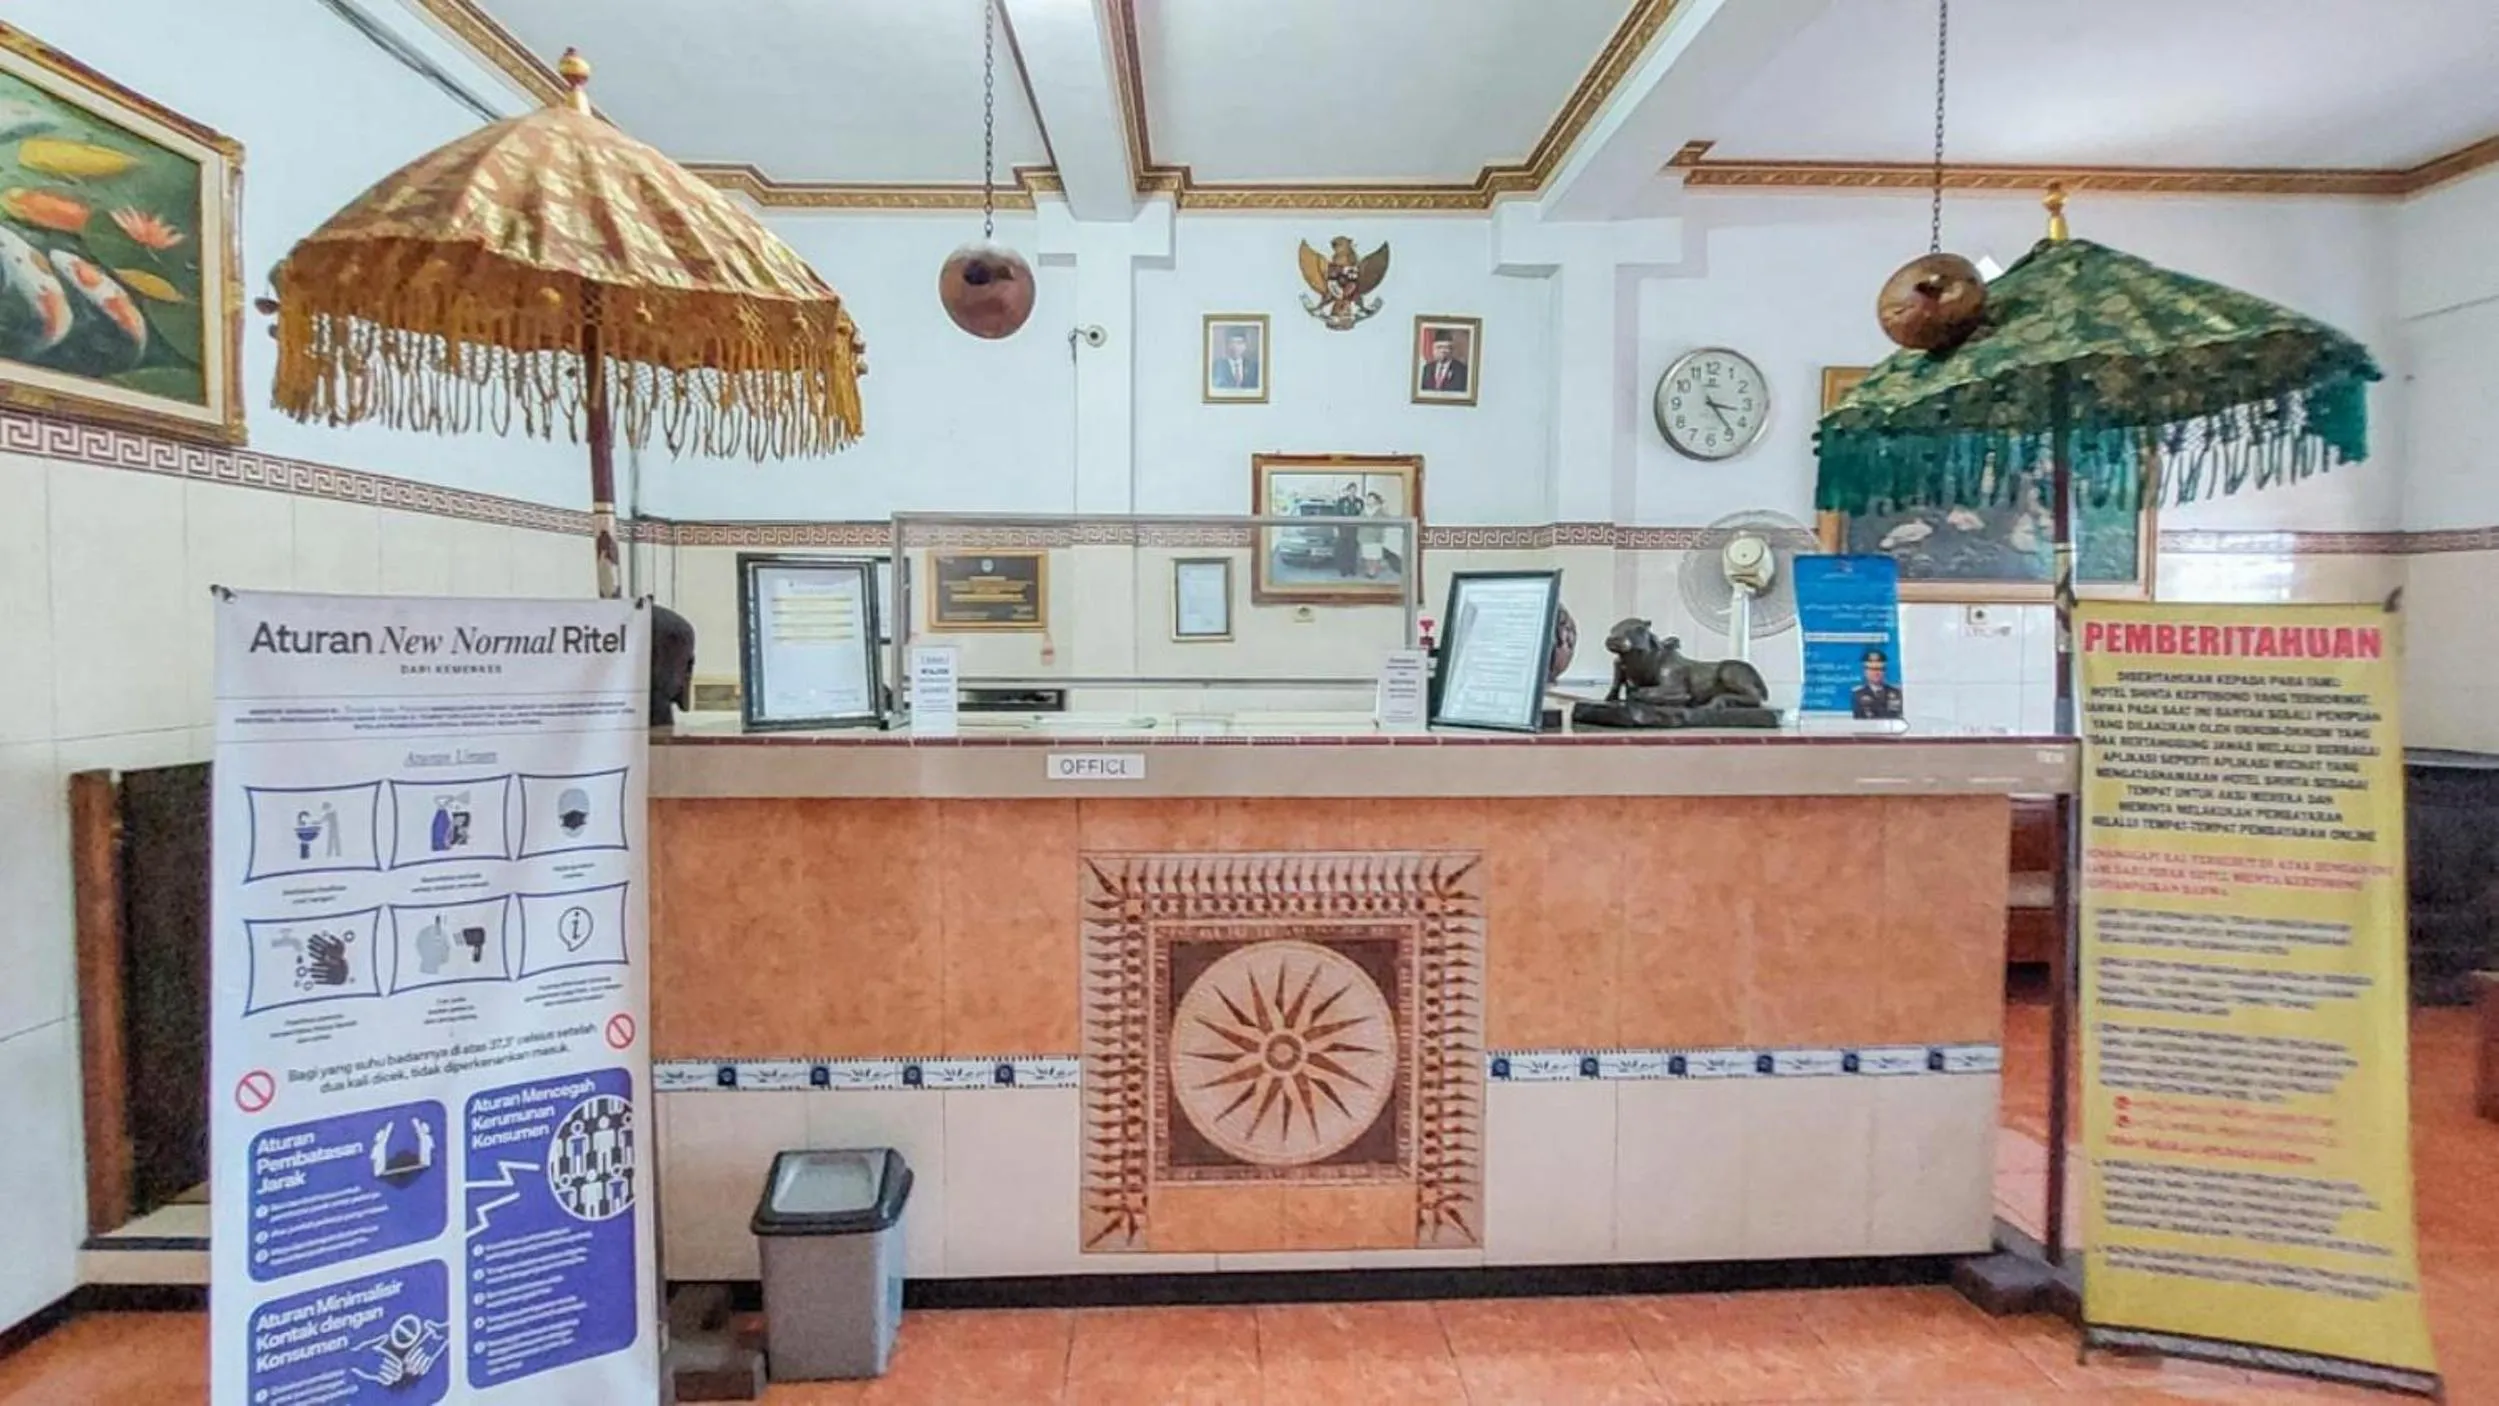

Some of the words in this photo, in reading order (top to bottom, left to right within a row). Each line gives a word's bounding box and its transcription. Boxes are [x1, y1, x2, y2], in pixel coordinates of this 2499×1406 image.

[250, 621, 373, 654] Aturan
[378, 625, 443, 655] New
[451, 625, 557, 655] Normal
[563, 624, 627, 654] Ritel
[2084, 622, 2382, 659] PEMBERITAHUAN
[471, 1093, 520, 1114] Aturan
[522, 1078, 596, 1103] Mencegah
[472, 1106, 555, 1131] Kerumunan
[257, 1132, 315, 1155] Aturan
[472, 1124, 549, 1149] Konsumen
[257, 1142, 363, 1175] Pembatasan
[256, 1170, 306, 1195] Jarak
[256, 1305, 314, 1332] Aturan
[317, 1279, 404, 1314] Minimalisir
[257, 1322, 318, 1352] Kontak
[320, 1306, 384, 1334] dengan
[256, 1335, 348, 1373] Konsumen
